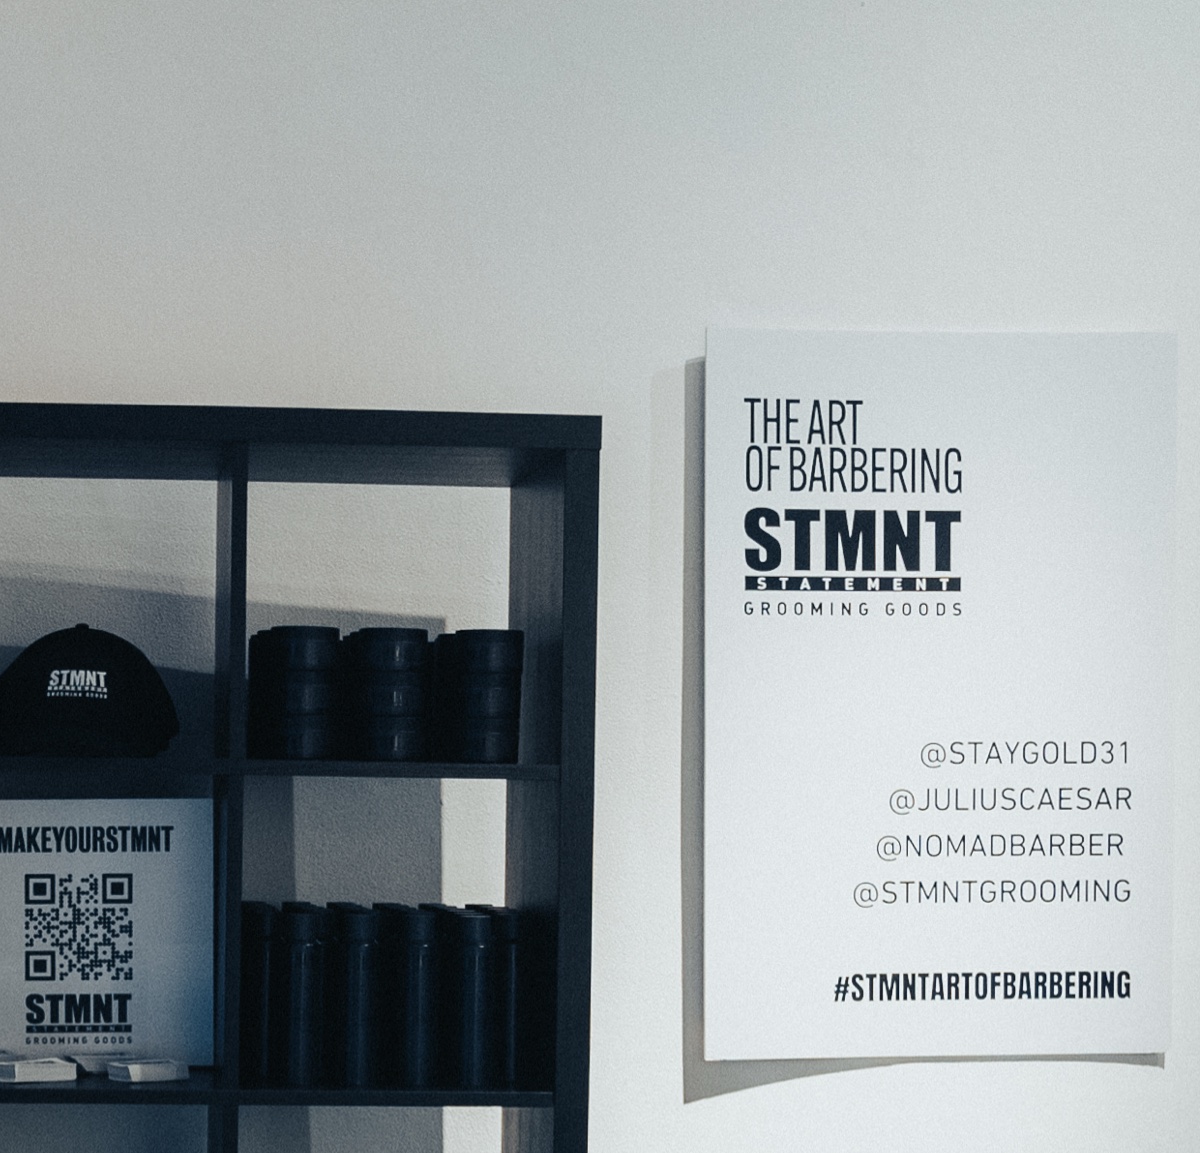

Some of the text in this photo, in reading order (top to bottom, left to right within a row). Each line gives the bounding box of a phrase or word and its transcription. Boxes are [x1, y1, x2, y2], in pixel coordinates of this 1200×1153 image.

[744, 398, 863, 445] THE ART
[745, 446, 962, 494] OF BARBERING
[744, 507, 961, 572] STMNT
[756, 577, 950, 591] STATEMENT
[744, 602, 962, 616] GROOMING GOODS
[49, 670, 106, 687] STMNT
[920, 741, 1130, 767] @STAYGOLD31
[889, 787, 1132, 816] @JULIUSCAESAR
[876, 834, 1123, 863] @NOMADBARBER
[853, 880, 1132, 909] @STMNTGROOMING
[834, 971, 1131, 1001] #STMNTARTOFBARBERING
[25, 994, 132, 1024] STMNT
[26, 1036, 132, 1045] GROOMING GOODS
